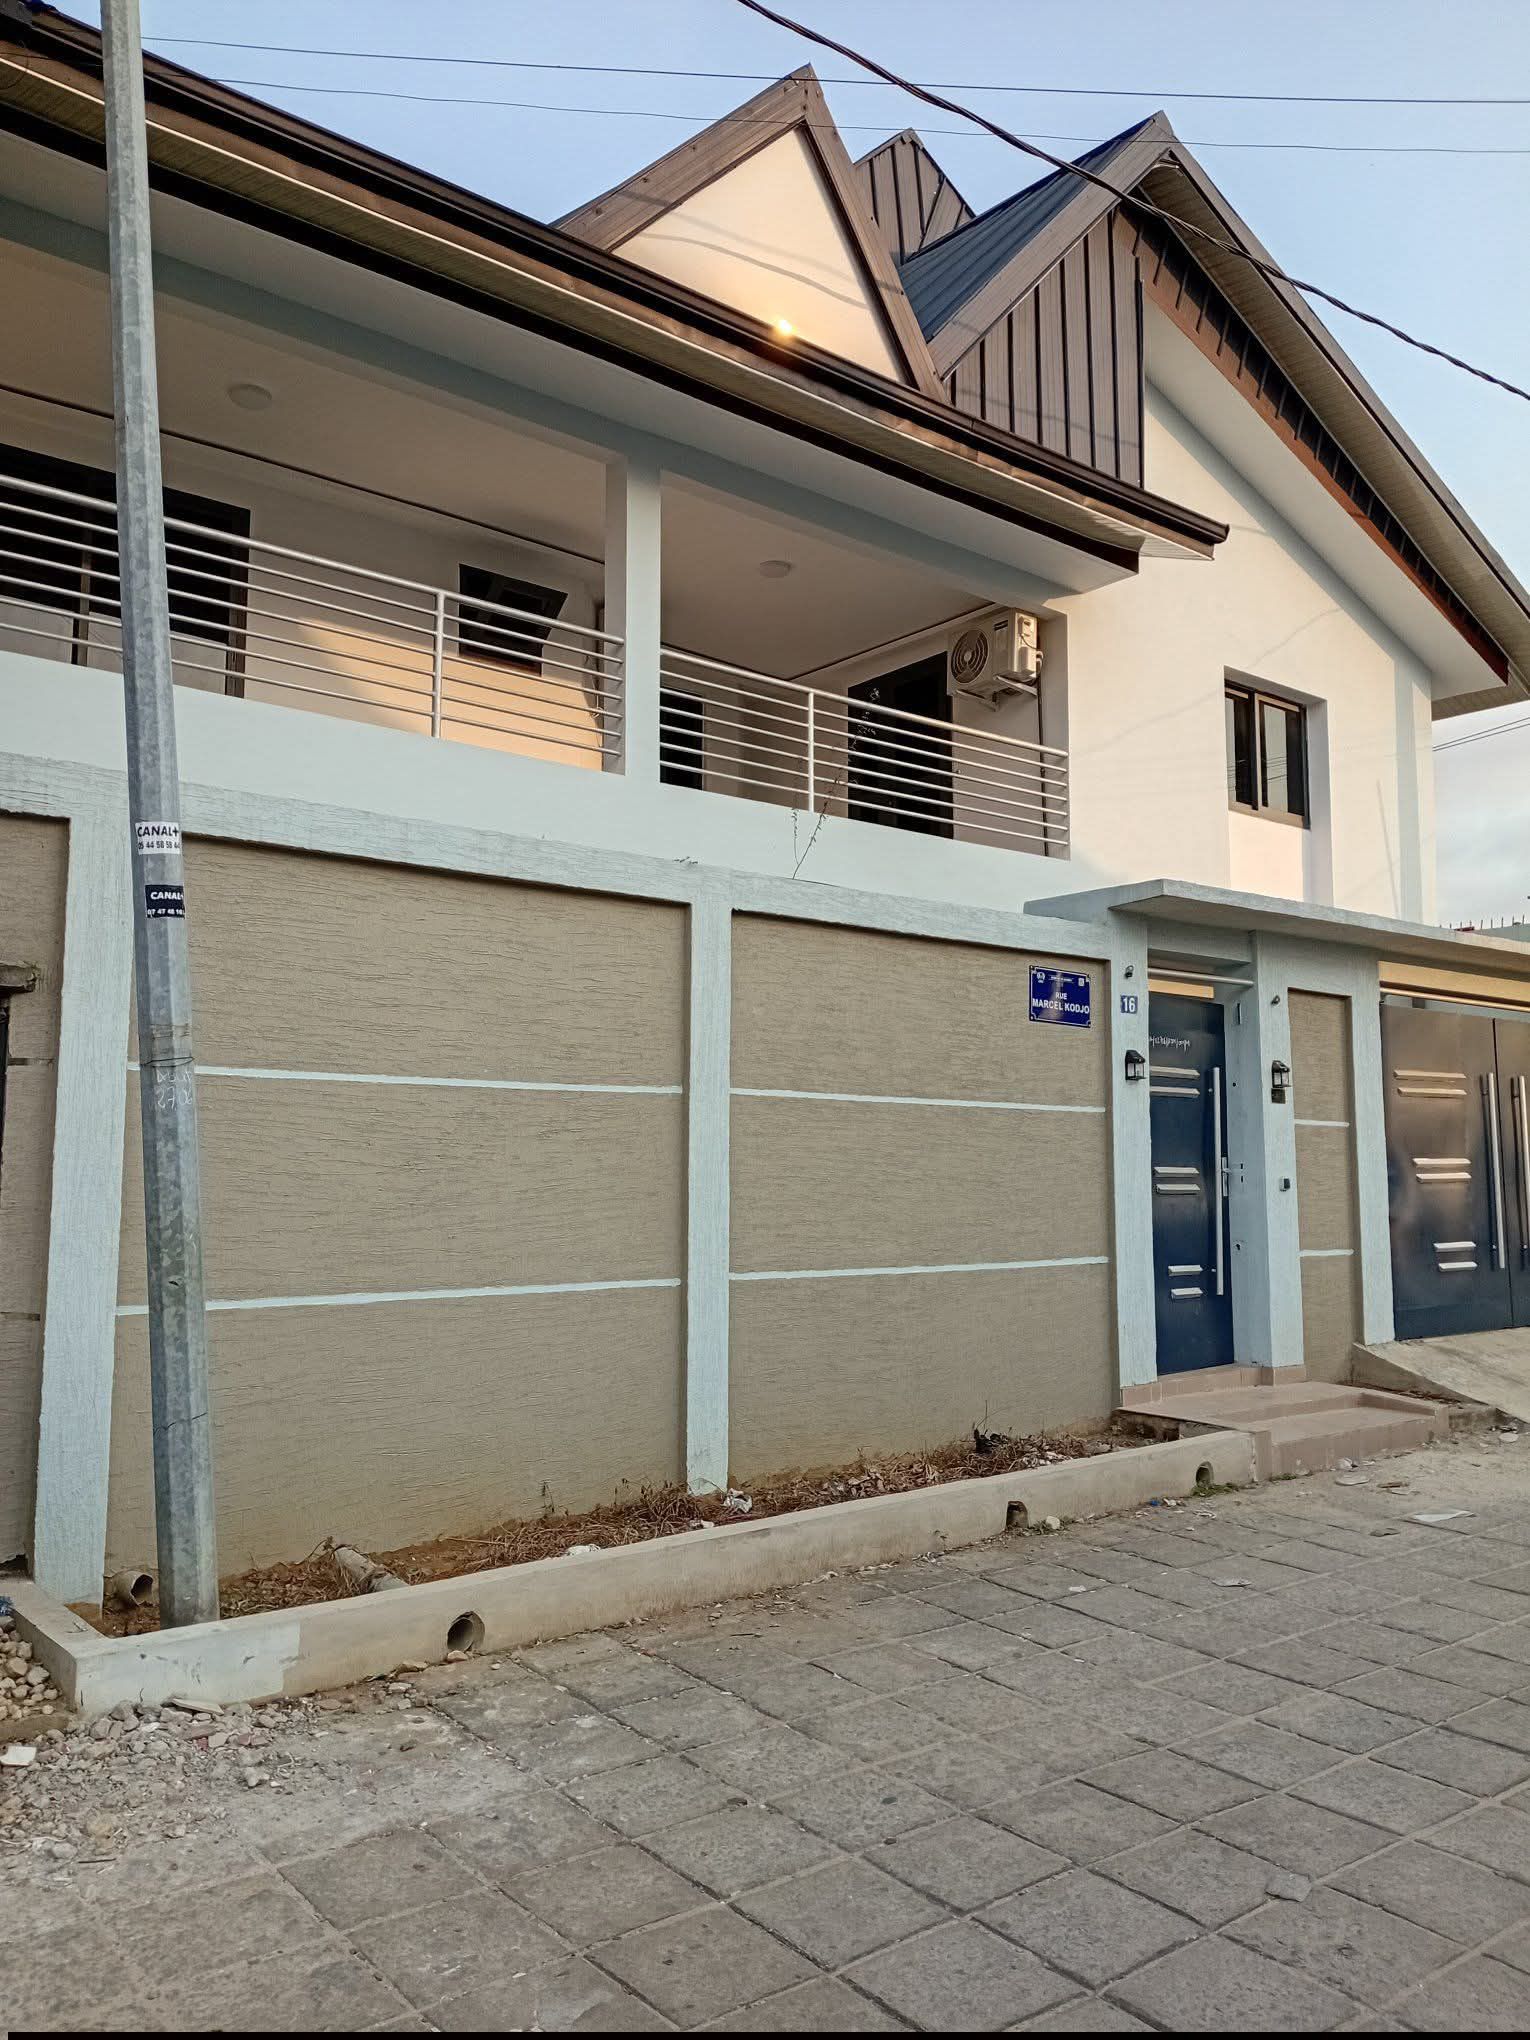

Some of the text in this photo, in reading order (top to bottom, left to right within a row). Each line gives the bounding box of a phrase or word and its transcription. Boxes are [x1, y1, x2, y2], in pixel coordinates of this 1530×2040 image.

[137, 825, 179, 837] CANAL+
[1055, 991, 1068, 1000] RUE
[1032, 998, 1090, 1014] MARCEL KODJO
[1122, 997, 1136, 1013] 16
